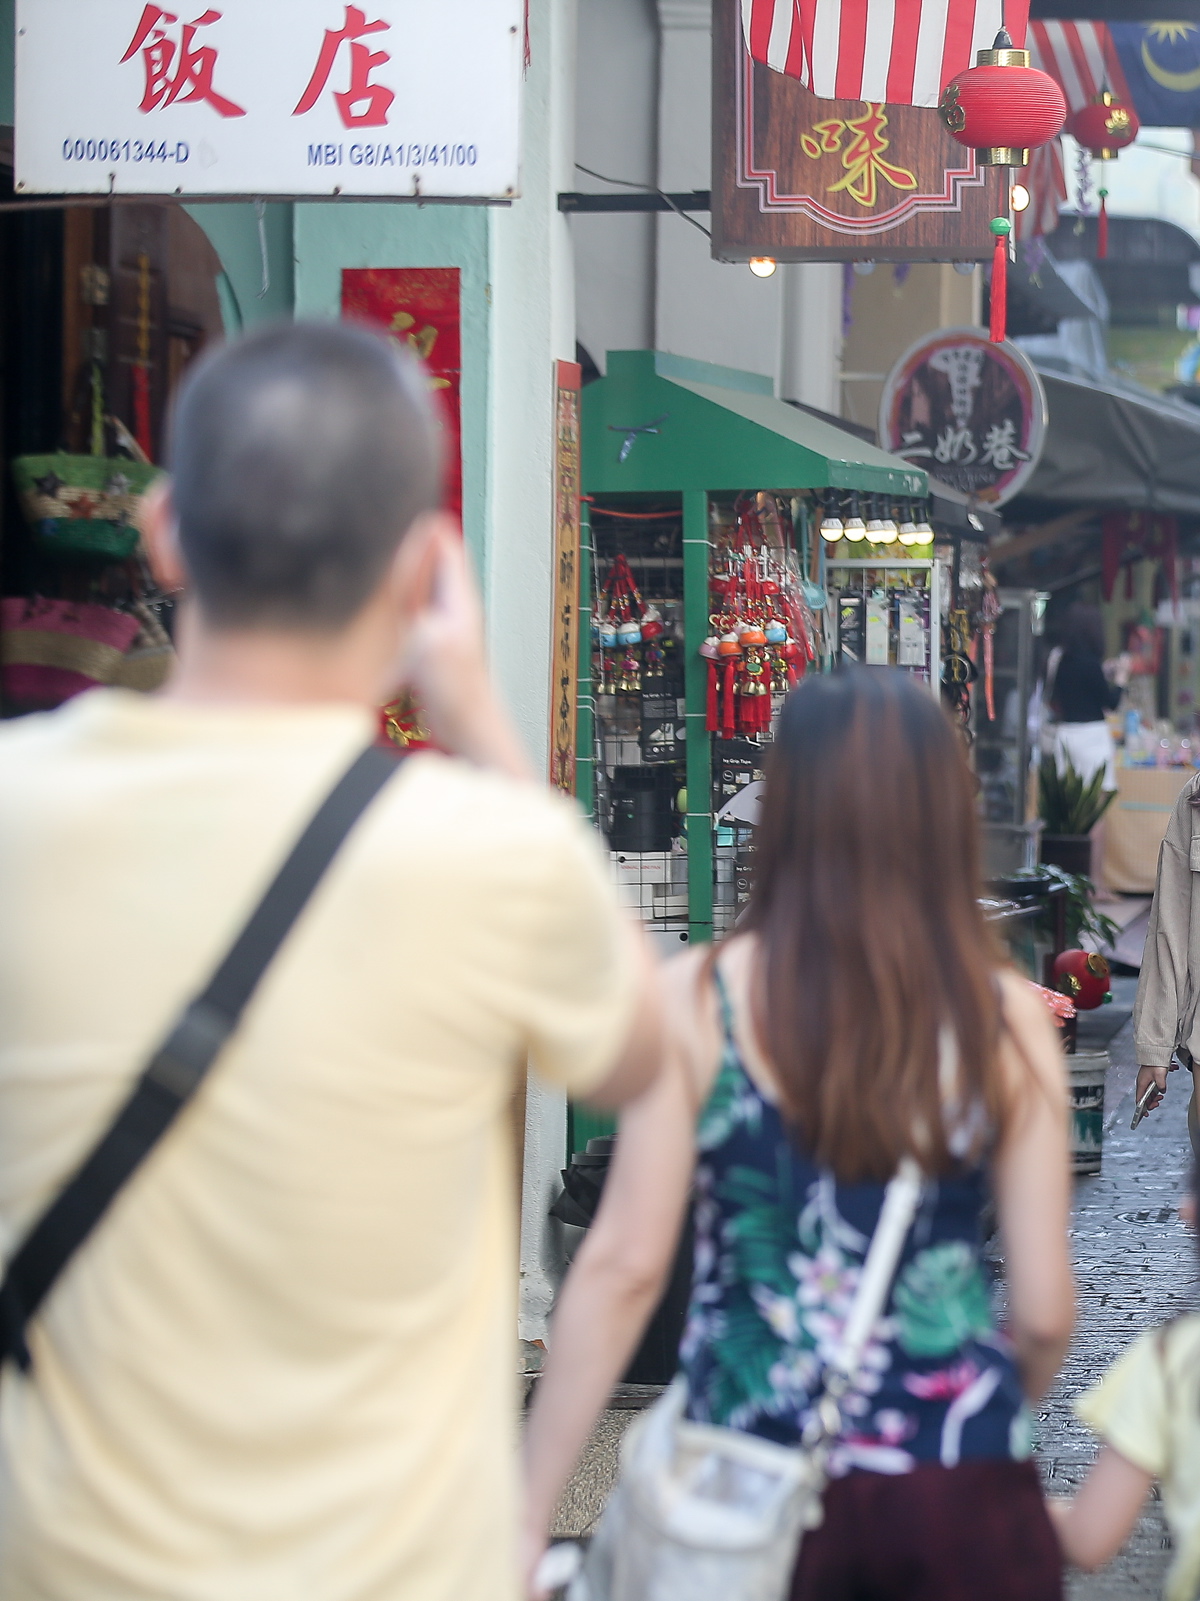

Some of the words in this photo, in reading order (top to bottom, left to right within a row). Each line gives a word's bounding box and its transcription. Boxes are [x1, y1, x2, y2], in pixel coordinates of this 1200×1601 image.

[118, 2, 393, 130] 飯店
[61, 137, 191, 164] 000061344-D
[307, 142, 343, 167] MBI
[349, 143, 479, 168] G8/A1/3/41/00
[800, 101, 918, 208] 味
[890, 418, 1032, 471] 二奶巷
